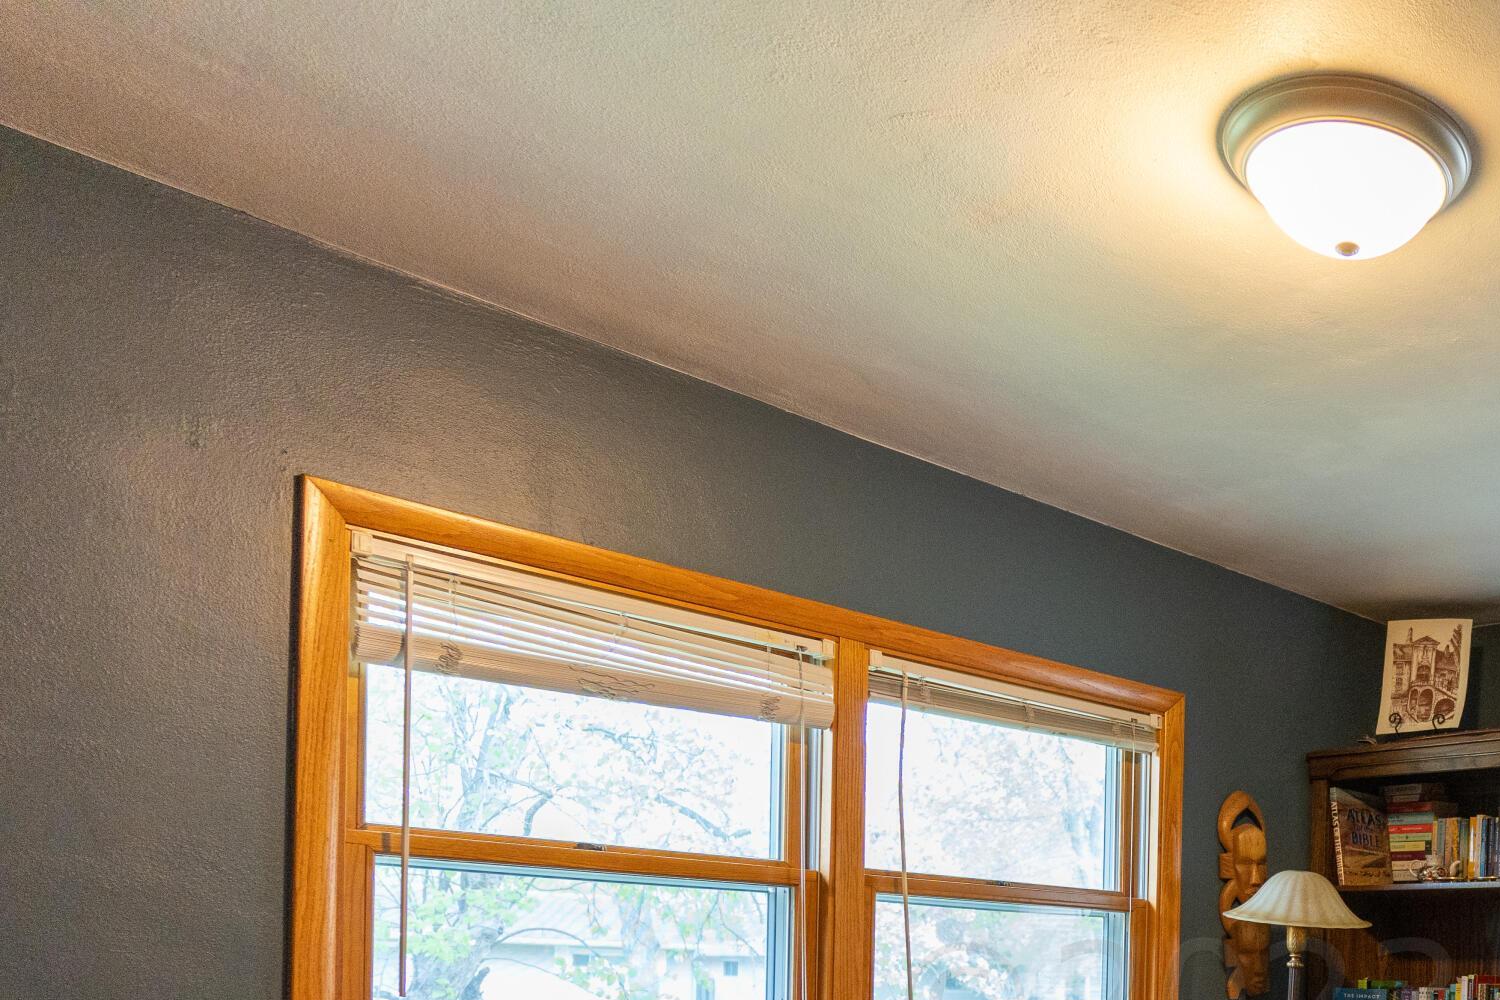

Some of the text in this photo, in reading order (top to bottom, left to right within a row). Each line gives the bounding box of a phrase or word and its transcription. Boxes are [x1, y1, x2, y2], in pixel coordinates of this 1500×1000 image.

[1330, 801, 1340, 827] ATLAS
[1346, 808, 1384, 825] ATLAS
[1351, 831, 1379, 847] BIBLE
